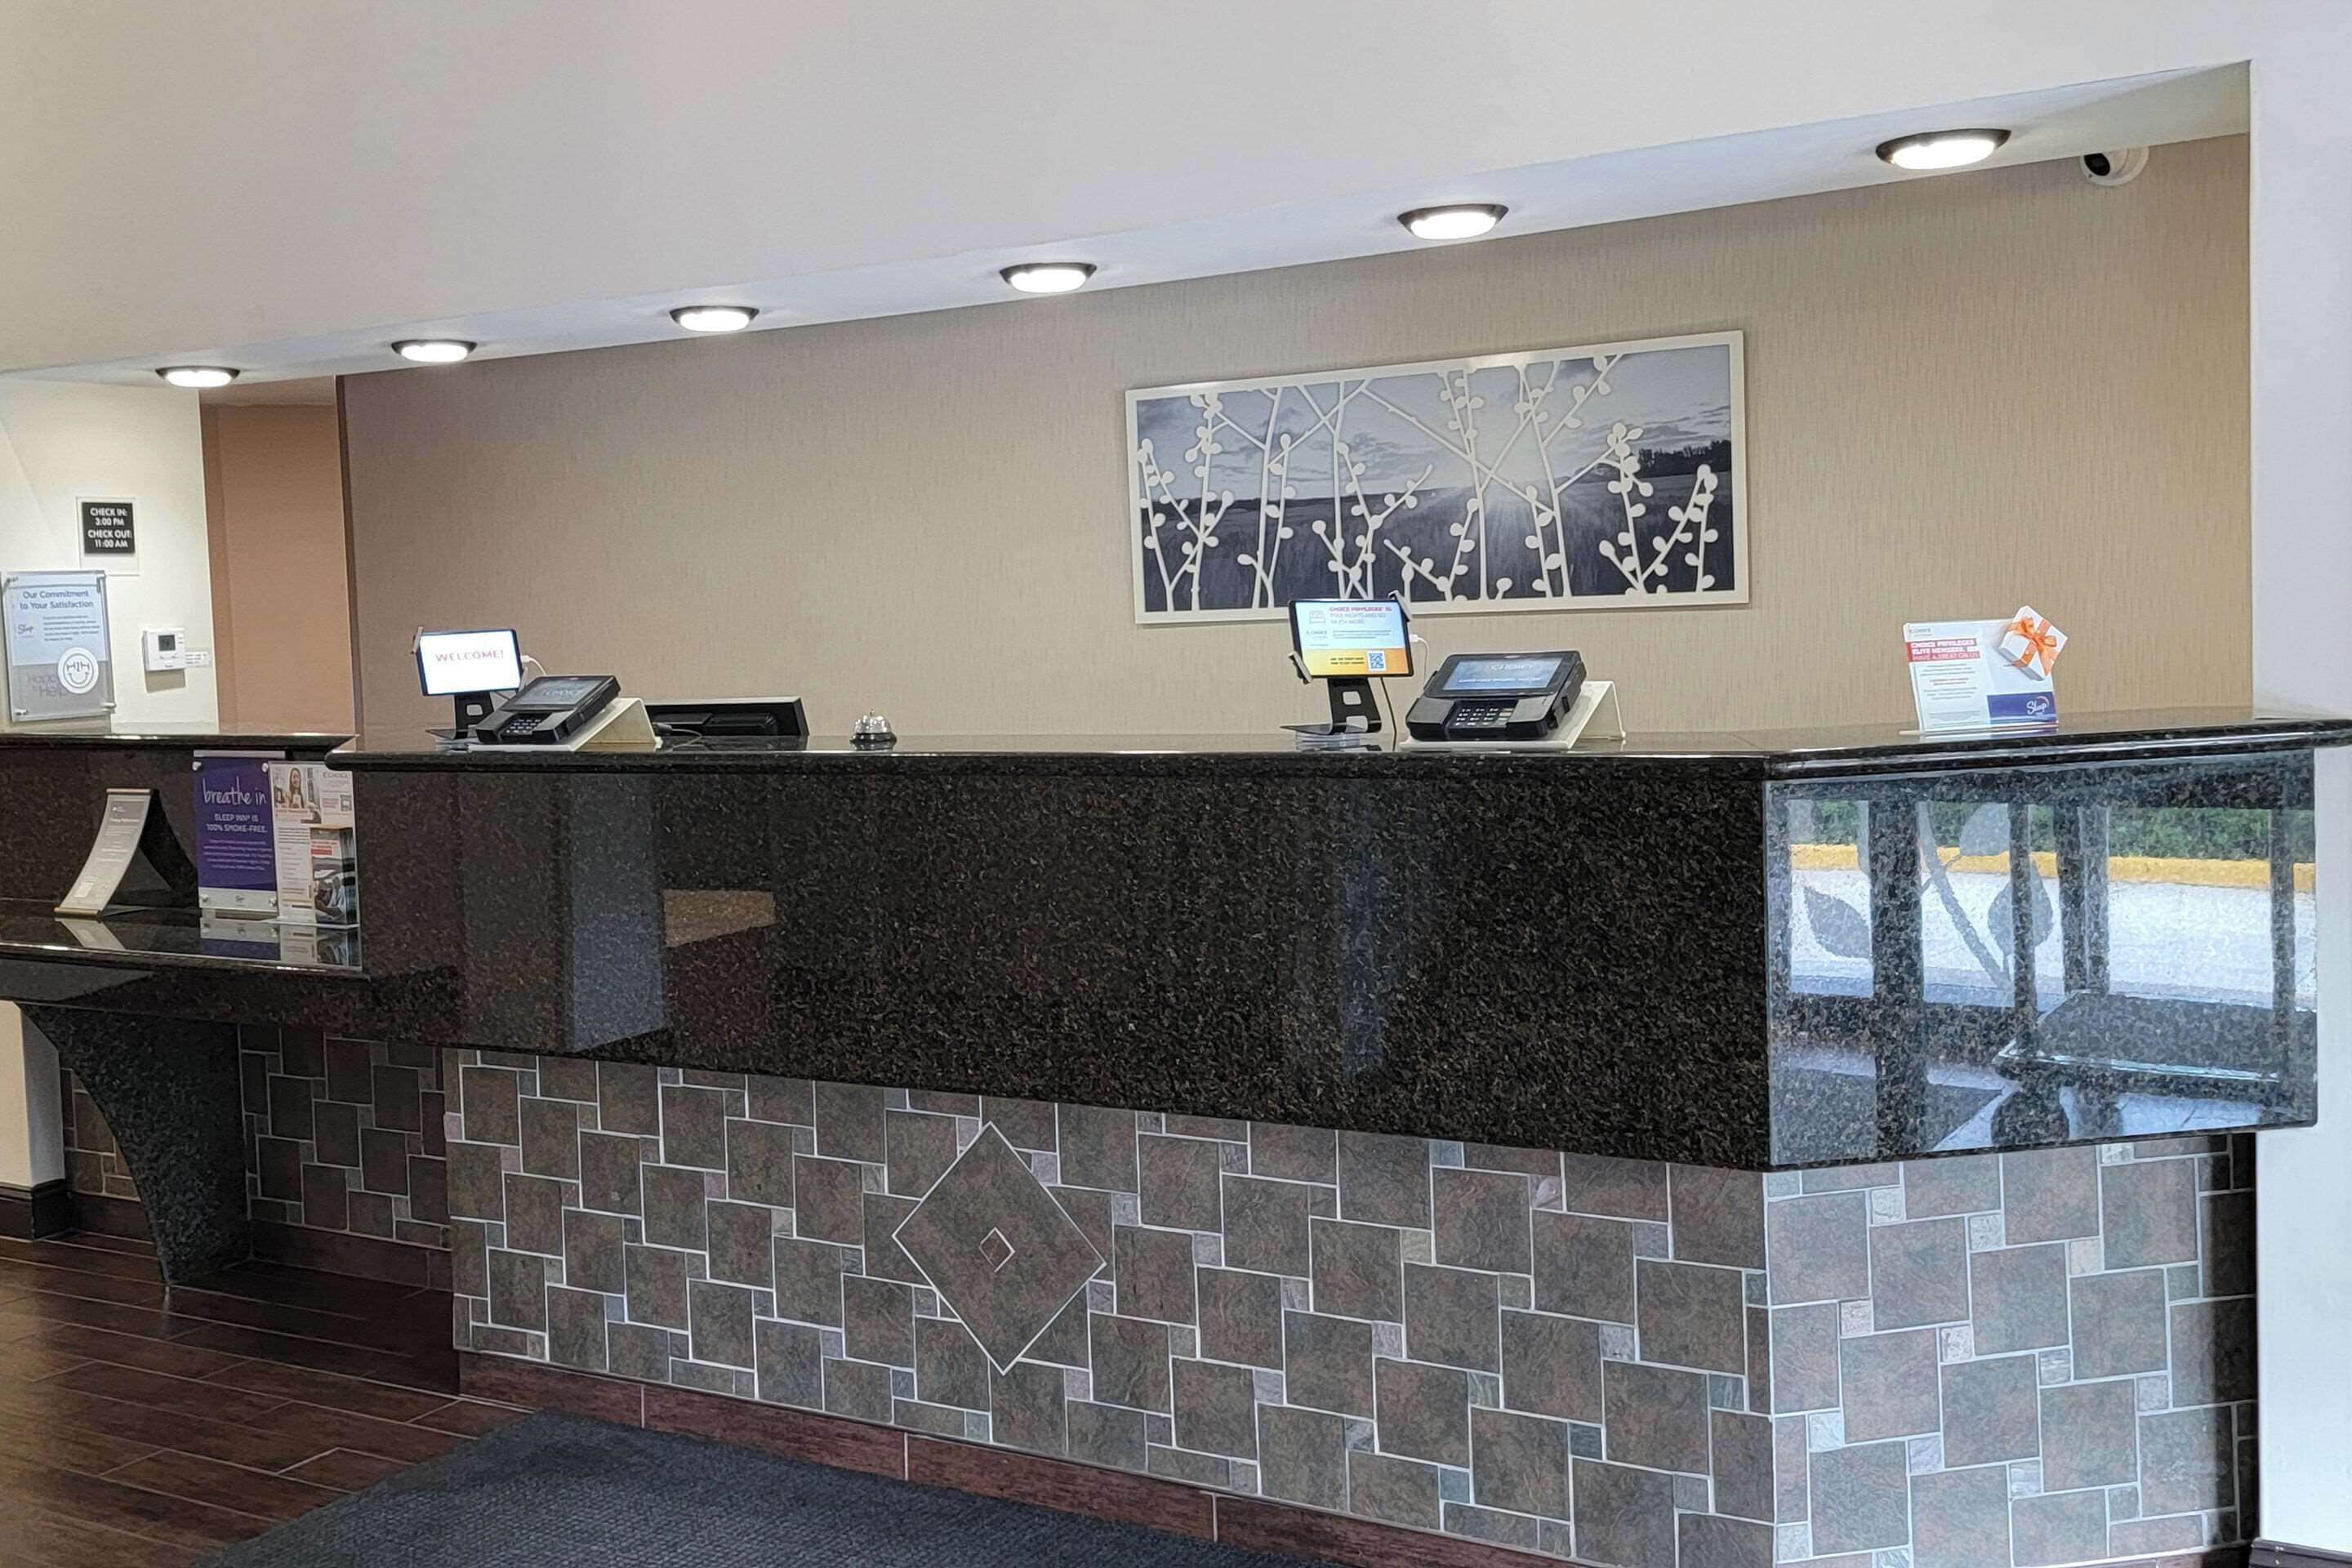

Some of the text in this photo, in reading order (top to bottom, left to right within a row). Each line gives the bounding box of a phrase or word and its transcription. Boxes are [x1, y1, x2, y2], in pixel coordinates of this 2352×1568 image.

[90, 507, 128, 516] CHECK IN:
[95, 517, 125, 526] 3:00 PM
[87, 529, 114, 538] CHECK
[95, 539, 128, 548] 11:00 AM
[23, 590, 89, 599] Our Commitment
[49, 600, 93, 609] Satisfaction
[434, 649, 504, 662] WELCOME!
[202, 775, 267, 805] breathe in
[214, 813, 234, 822] SLEEP
[206, 822, 223, 831] 100%
